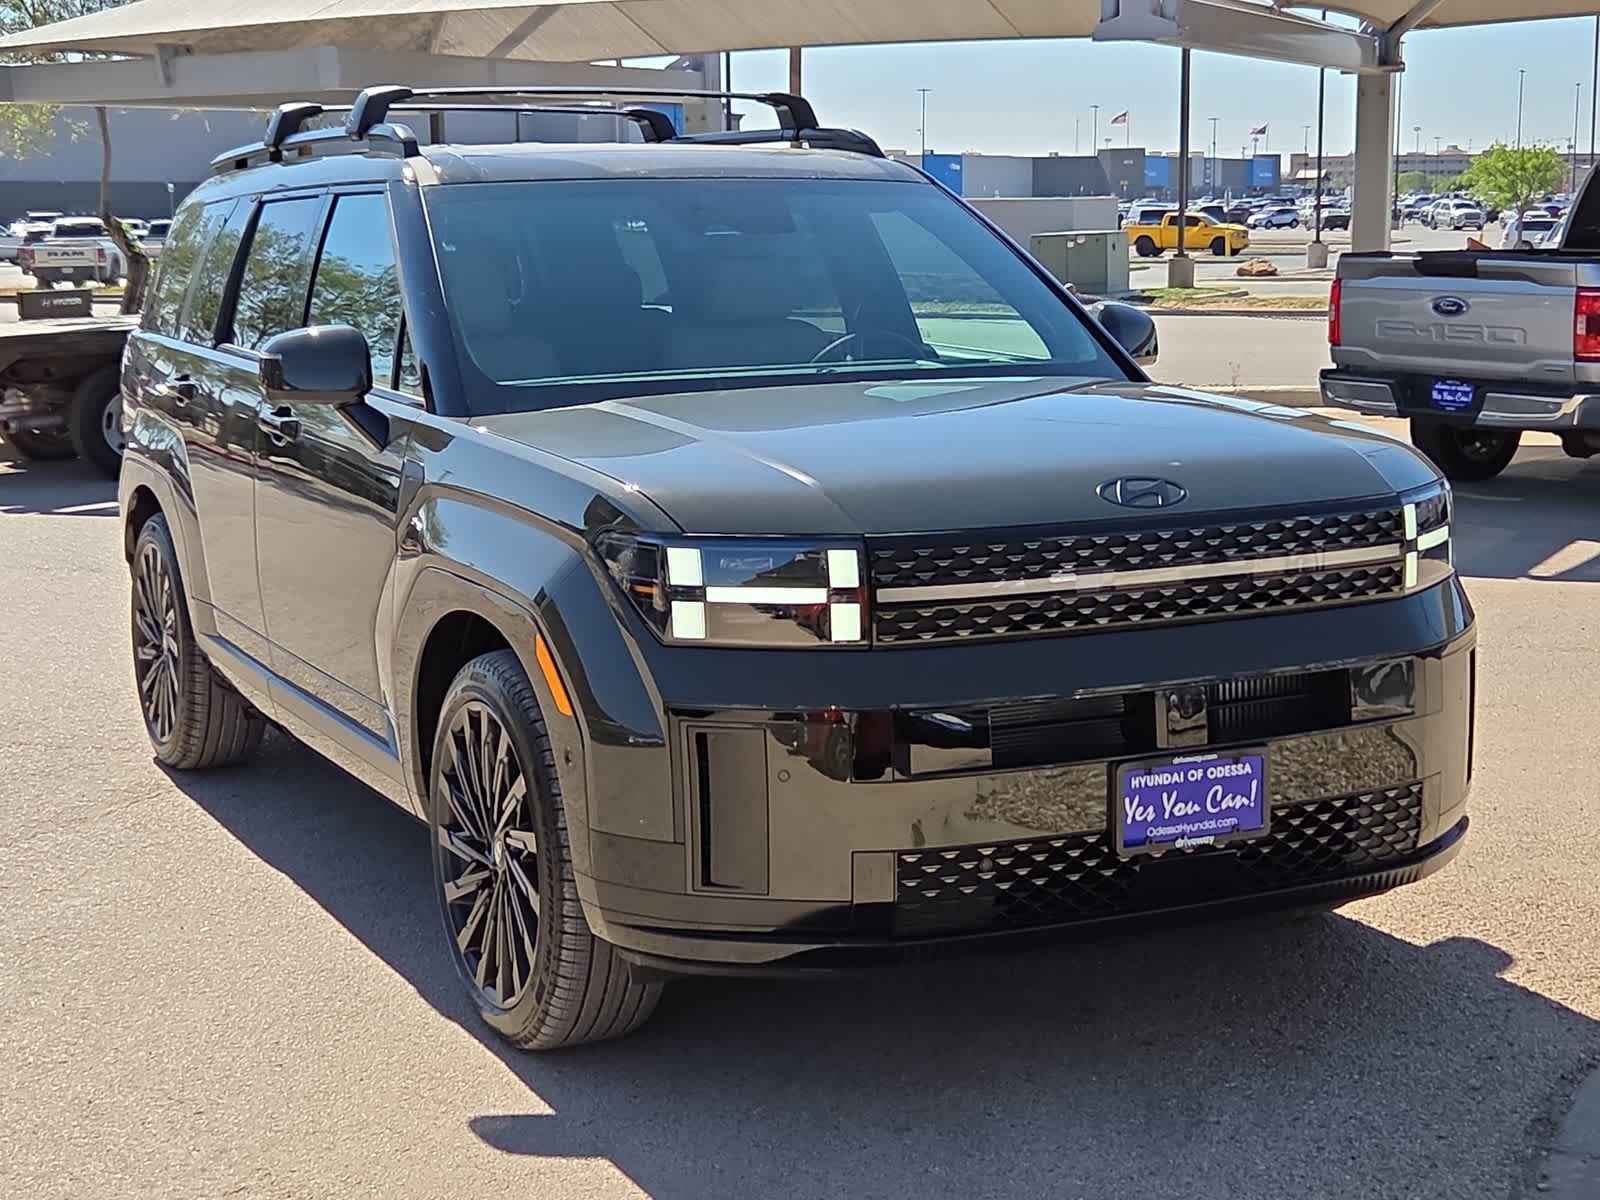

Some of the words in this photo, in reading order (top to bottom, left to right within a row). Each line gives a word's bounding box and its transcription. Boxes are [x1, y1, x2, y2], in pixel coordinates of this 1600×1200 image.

[1375, 320, 1528, 345] F-150
[1131, 771, 1184, 789] HYUNDAI
[1187, 769, 1203, 782] OF
[1207, 762, 1252, 779] ODESSA
[1124, 795, 1156, 824] Yes
[1162, 790, 1200, 819] You
[1206, 779, 1258, 813] Can!
[1146, 817, 1238, 837] OdessaHyundai.com
[1175, 836, 1215, 848] driveway
